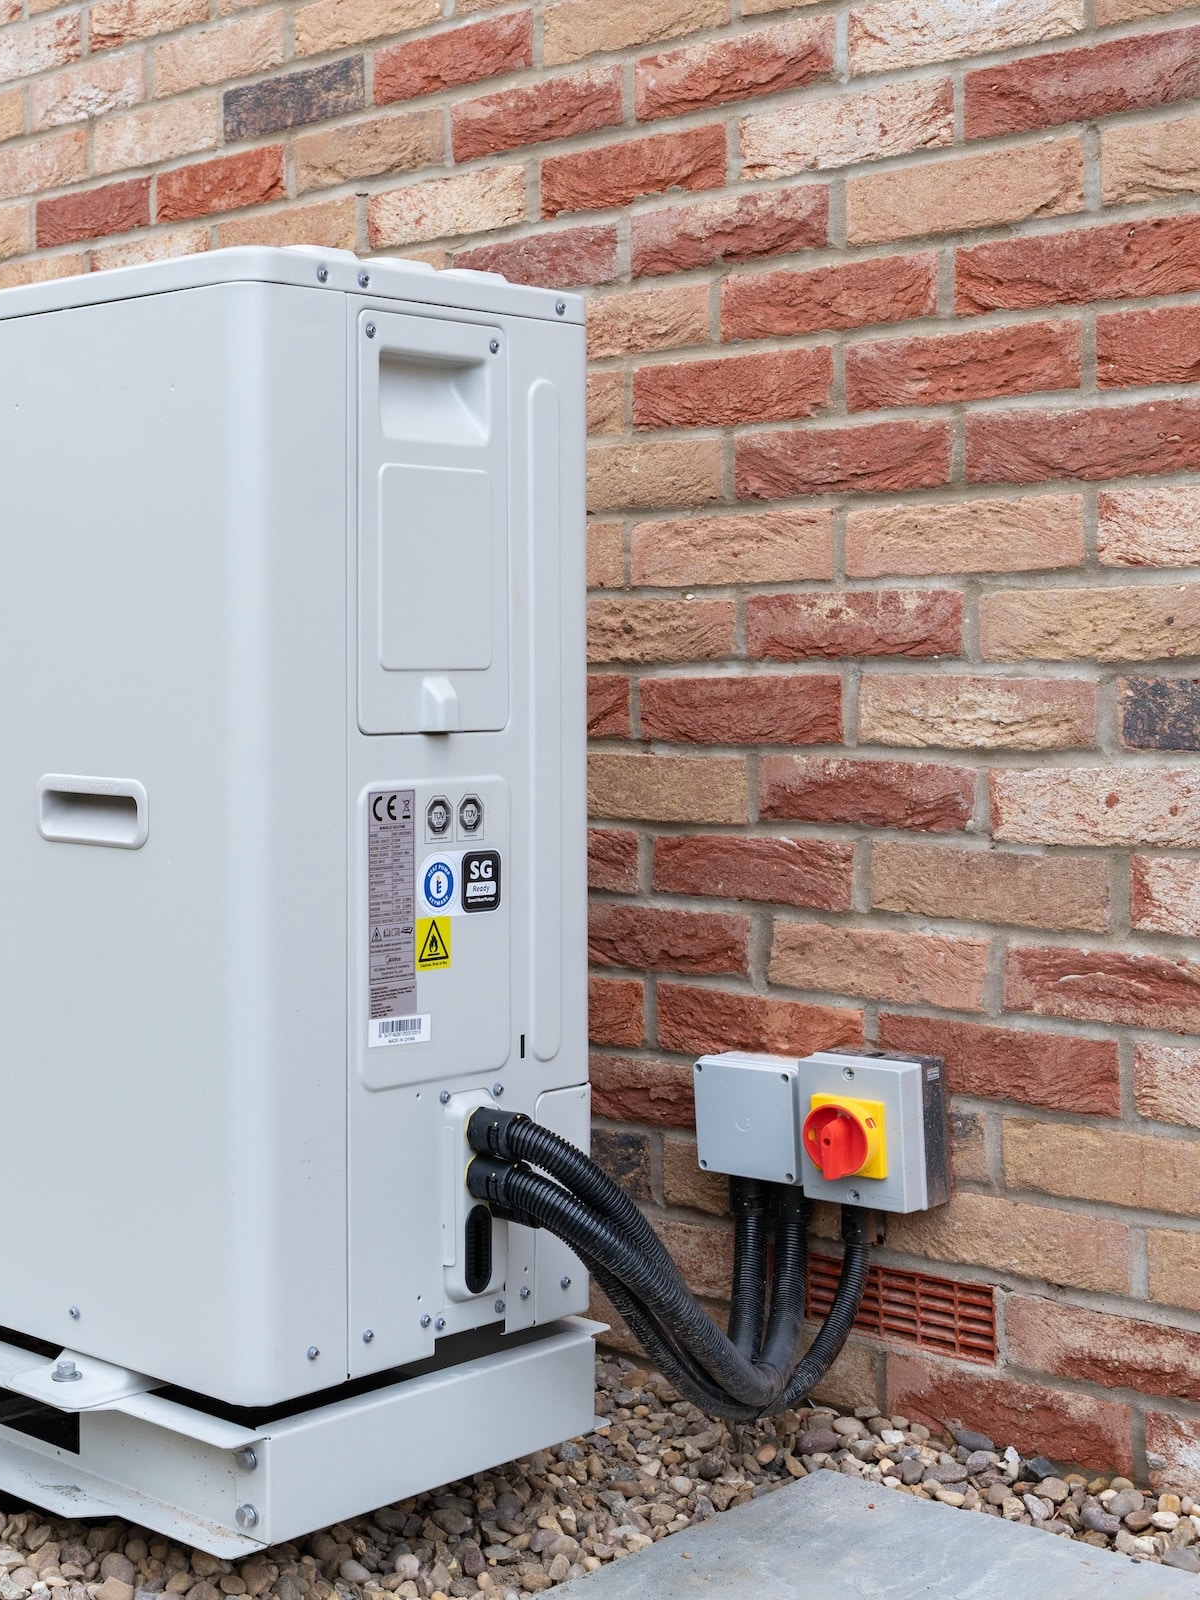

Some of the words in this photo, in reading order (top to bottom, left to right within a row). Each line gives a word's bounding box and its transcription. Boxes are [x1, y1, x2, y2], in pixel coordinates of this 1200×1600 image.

[372, 794, 397, 822] CE
[470, 860, 493, 880] SG
[472, 885, 490, 893] Ready
[428, 896, 450, 906] KEYMARK
